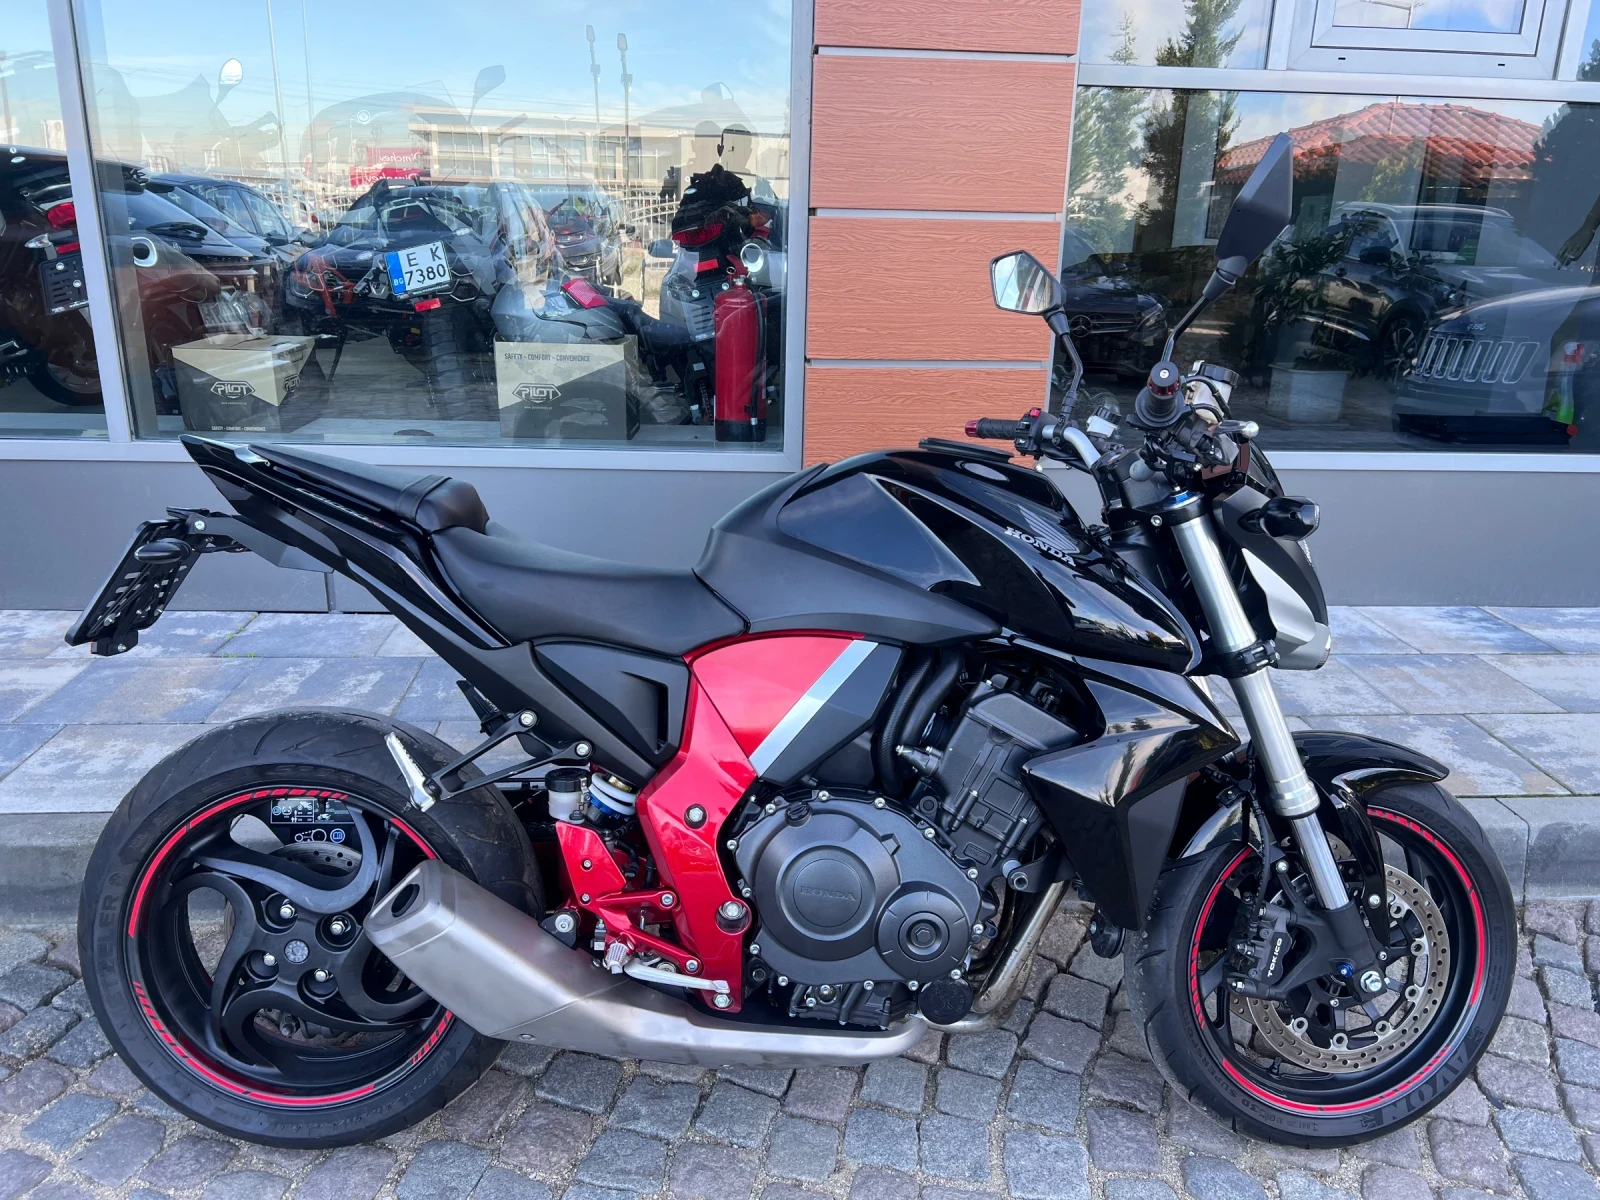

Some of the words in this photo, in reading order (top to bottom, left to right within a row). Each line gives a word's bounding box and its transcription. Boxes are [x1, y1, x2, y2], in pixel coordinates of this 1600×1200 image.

[406, 252, 419, 267] E
[430, 246, 442, 261] K
[405, 263, 446, 286] 7380
[504, 352, 523, 360] SAFETY
[528, 353, 551, 361] COMFORT
[556, 354, 591, 362] CONVENIENCE
[216, 383, 250, 396] PILOT
[520, 386, 555, 400] PILOT
[1004, 526, 1076, 567] HONDA
[800, 885, 857, 902] HONDA
[1267, 937, 1283, 978] TOKICO
[1381, 1044, 1470, 1121] AVON
